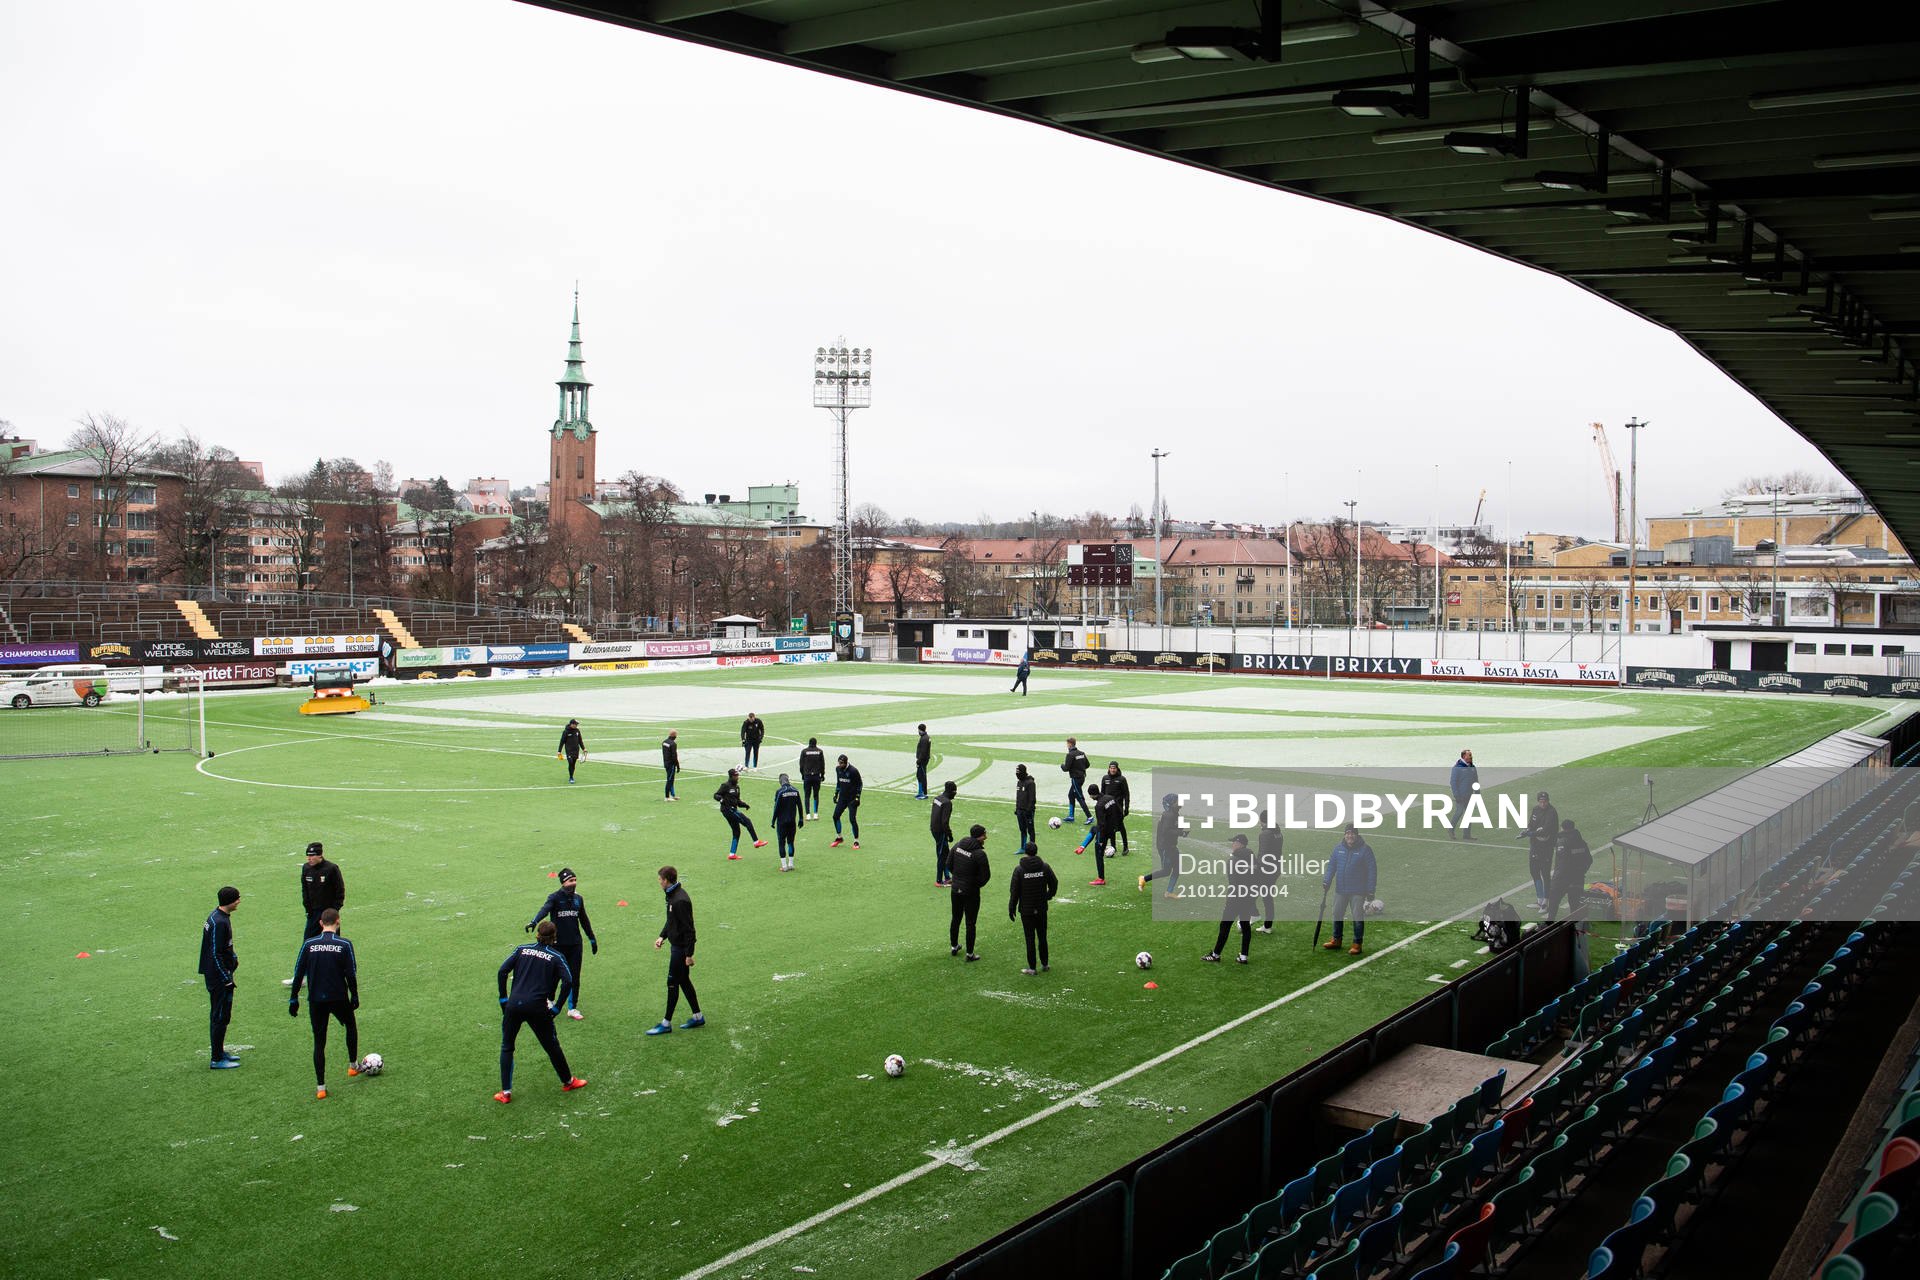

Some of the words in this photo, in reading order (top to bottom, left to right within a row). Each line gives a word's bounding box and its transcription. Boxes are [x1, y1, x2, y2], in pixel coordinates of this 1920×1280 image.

[782, 640, 810, 648] Danske
[4, 650, 48, 658] CHAMPIONS
[91, 645, 131, 657] KOPPARBERG
[811, 652, 832, 661] SKF
[785, 654, 805, 662] SKF
[1243, 655, 1313, 670] BRIXLY
[1335, 658, 1411, 673] BRIXLY
[1431, 665, 1465, 675] RASTA
[235, 664, 275, 679] Finans
[1484, 667, 1519, 677] RASTA
[1523, 668, 1559, 678] RASTA
[1579, 669, 1616, 680] RASTA
[1635, 671, 1675, 683] KOPPARBERG
[1696, 672, 1737, 685] KOPPARBERG
[1758, 675, 1801, 688] KOPPARBERG
[1824, 678, 1868, 691] KOPPARBERG
[310, 944, 342, 953] SERNEKE
[522, 948, 553, 961] SERNEKE
